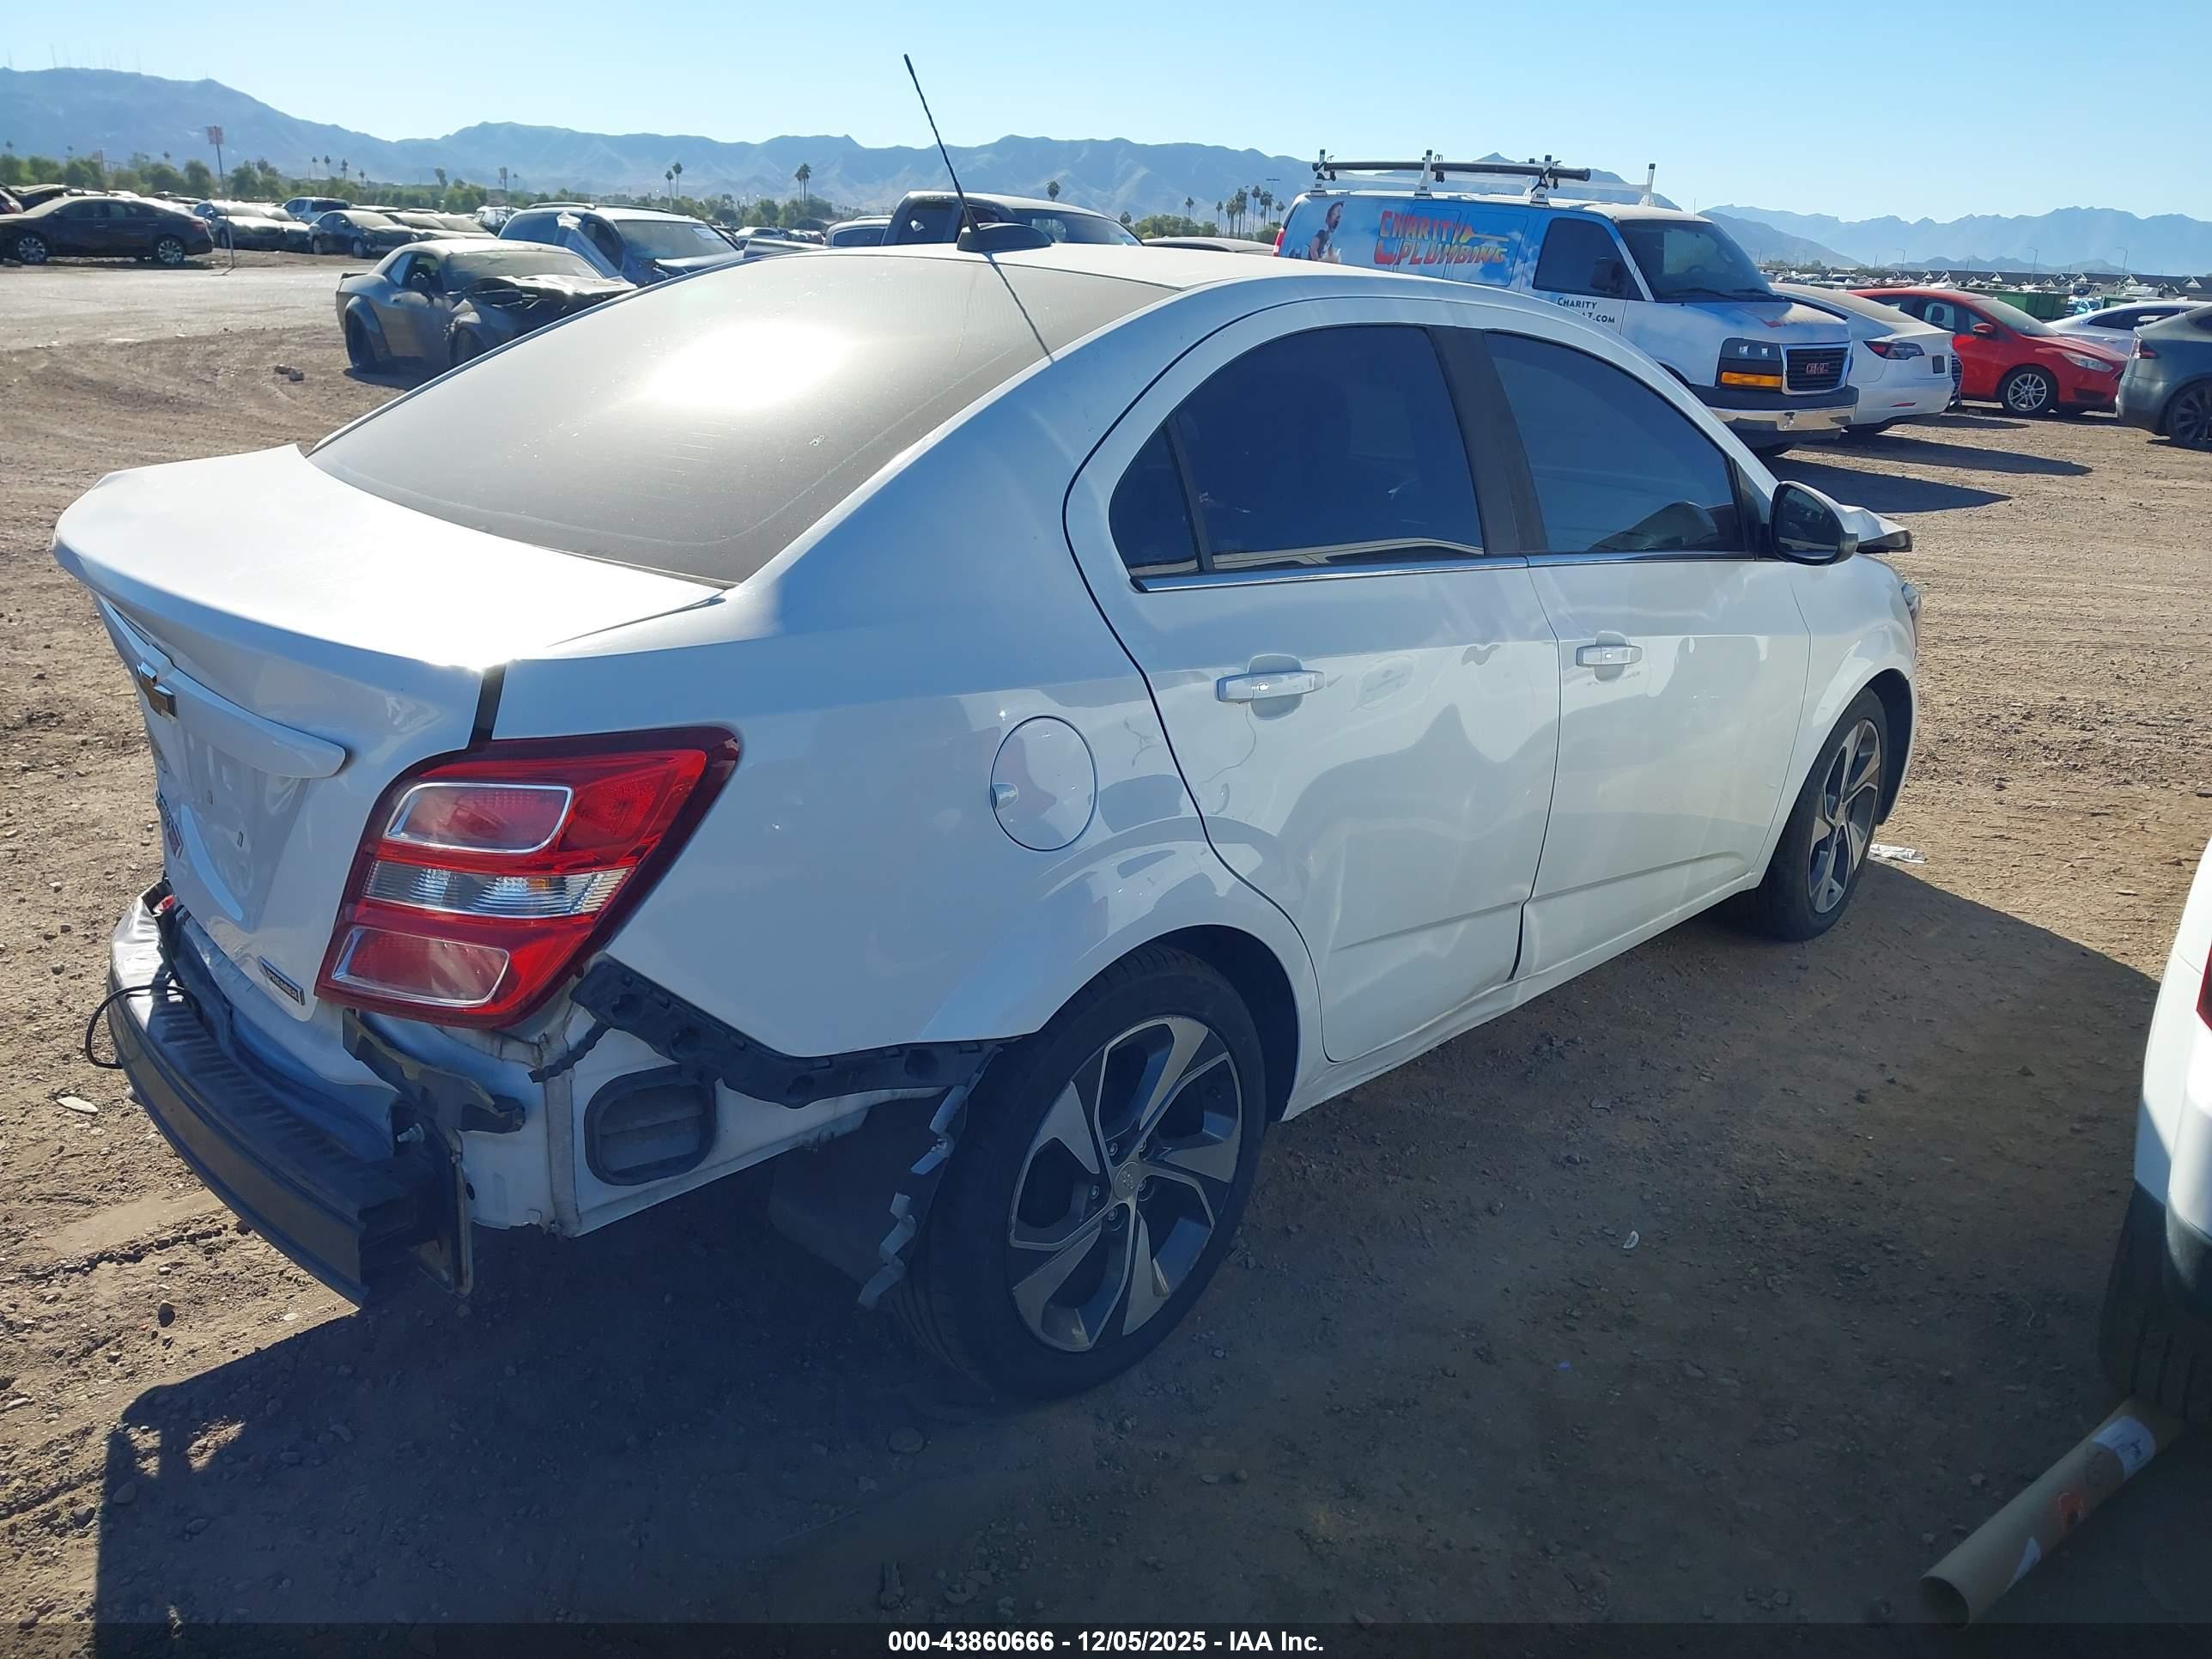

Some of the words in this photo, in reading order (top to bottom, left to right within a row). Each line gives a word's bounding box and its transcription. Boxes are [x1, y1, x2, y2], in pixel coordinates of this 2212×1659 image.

[1379, 210, 1465, 243] CHARITY
[1394, 239, 1508, 265] PLUMBING
[1557, 297, 1597, 309] CHARITY
[1807, 362, 1829, 374] GMC
